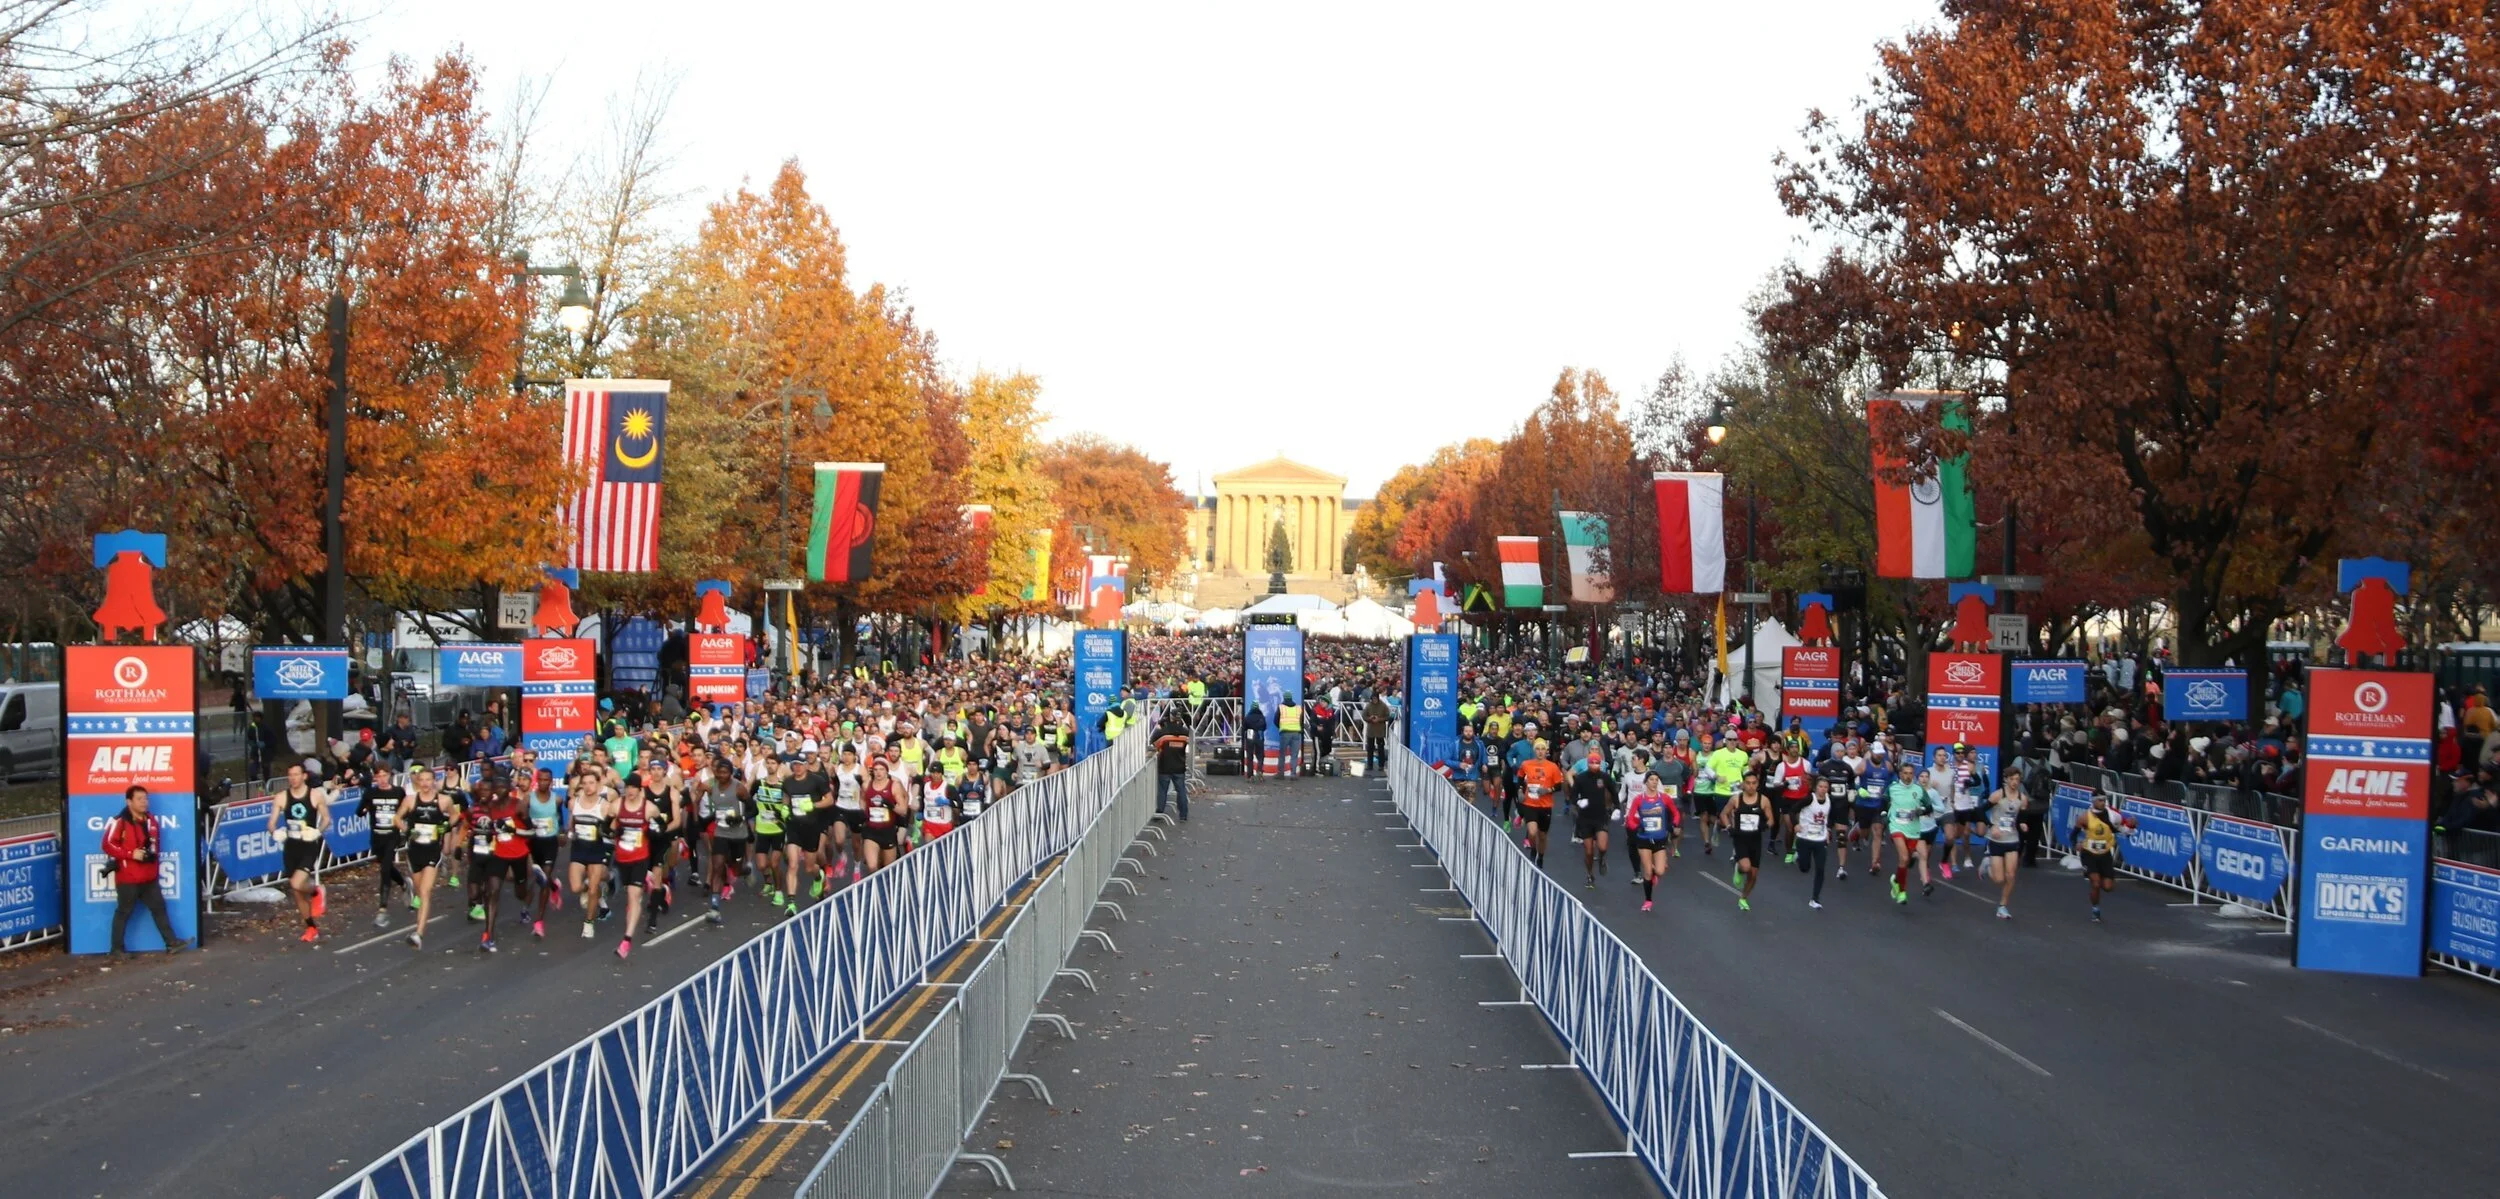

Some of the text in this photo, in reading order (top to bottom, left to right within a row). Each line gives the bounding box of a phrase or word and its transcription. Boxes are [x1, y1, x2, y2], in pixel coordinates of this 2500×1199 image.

[505, 608, 526, 624] H-2
[1254, 623, 1290, 631] GARMIN
[701, 638, 734, 648] AACR
[2001, 630, 2020, 646] H-1
[458, 651, 504, 665] AACR
[1253, 647, 1296, 657] PHILADELPHIA
[1794, 651, 1828, 661] AACR
[125, 666, 137, 678] R
[2028, 668, 2067, 681] AACR
[95, 688, 167, 699] ROTHMAN
[2366, 691, 2377, 702] R
[1789, 697, 1832, 707] DUNKIN'
[537, 707, 580, 717] ULTRA
[2335, 712, 2405, 724] ROTHMAN
[1941, 719, 1984, 732] ULTRA
[90, 746, 173, 772] ACME
[536, 750, 577, 761] USINE
[2325, 768, 2408, 796] ACME
[338, 813, 371, 837] GARM
[237, 829, 285, 861] GEIC
[2129, 830, 2177, 856] GARMIN
[2320, 836, 2408, 854] GARMIN
[2216, 847, 2264, 881] GEICO
[2320, 882, 2402, 914] DICK'S
[2453, 891, 2498, 915] COMCAST
[15, 914, 35, 927] FAST
[2321, 909, 2400, 920] SPORTING GOODS
[2451, 910, 2498, 937] BUSINESS
[2450, 939, 2496, 960] BEYOND FAST
